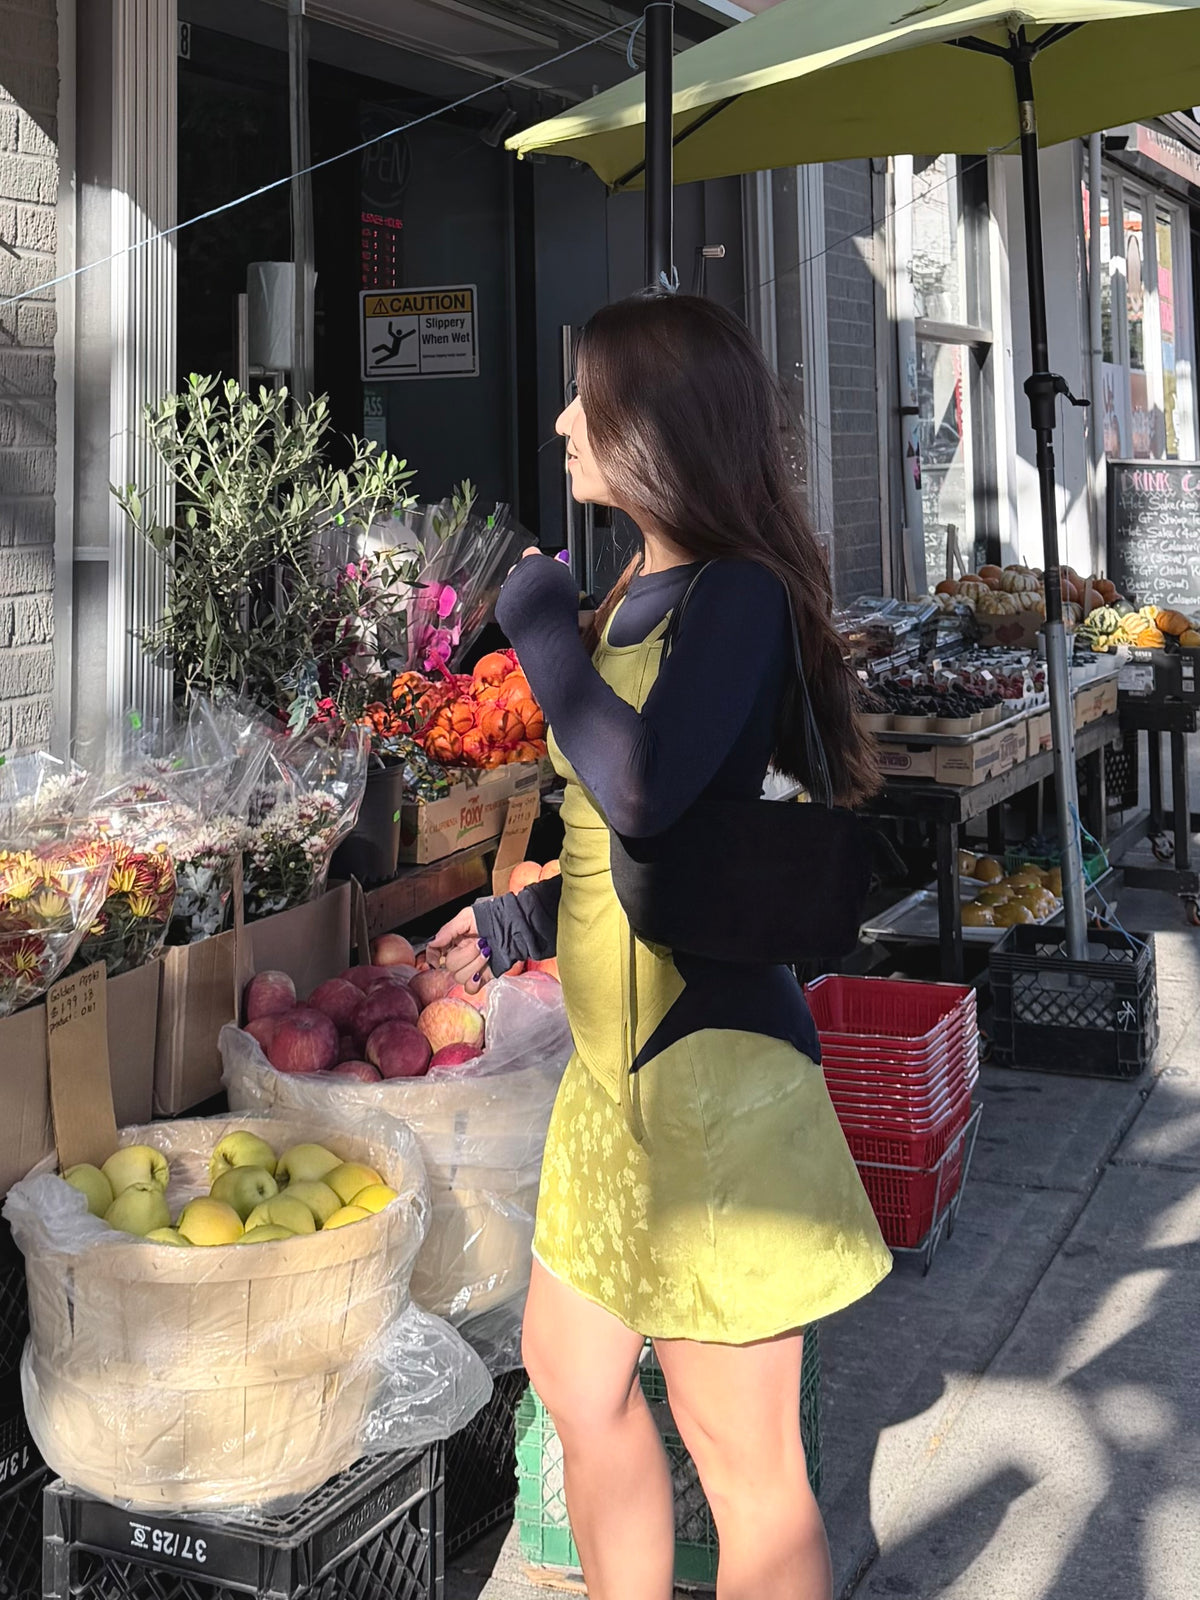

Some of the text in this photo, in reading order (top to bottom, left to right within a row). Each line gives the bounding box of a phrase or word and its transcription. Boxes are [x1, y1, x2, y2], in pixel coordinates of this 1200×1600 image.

[361, 140, 407, 185] PEN
[389, 293, 466, 313] CAUTION
[425, 317, 465, 330] Slippery
[421, 332, 470, 345] When Wet
[1121, 471, 1170, 492] DRINK
[460, 803, 483, 829] FOXY
[50, 984, 75, 1003] Golden
[151, 1528, 207, 1564] 37/25
